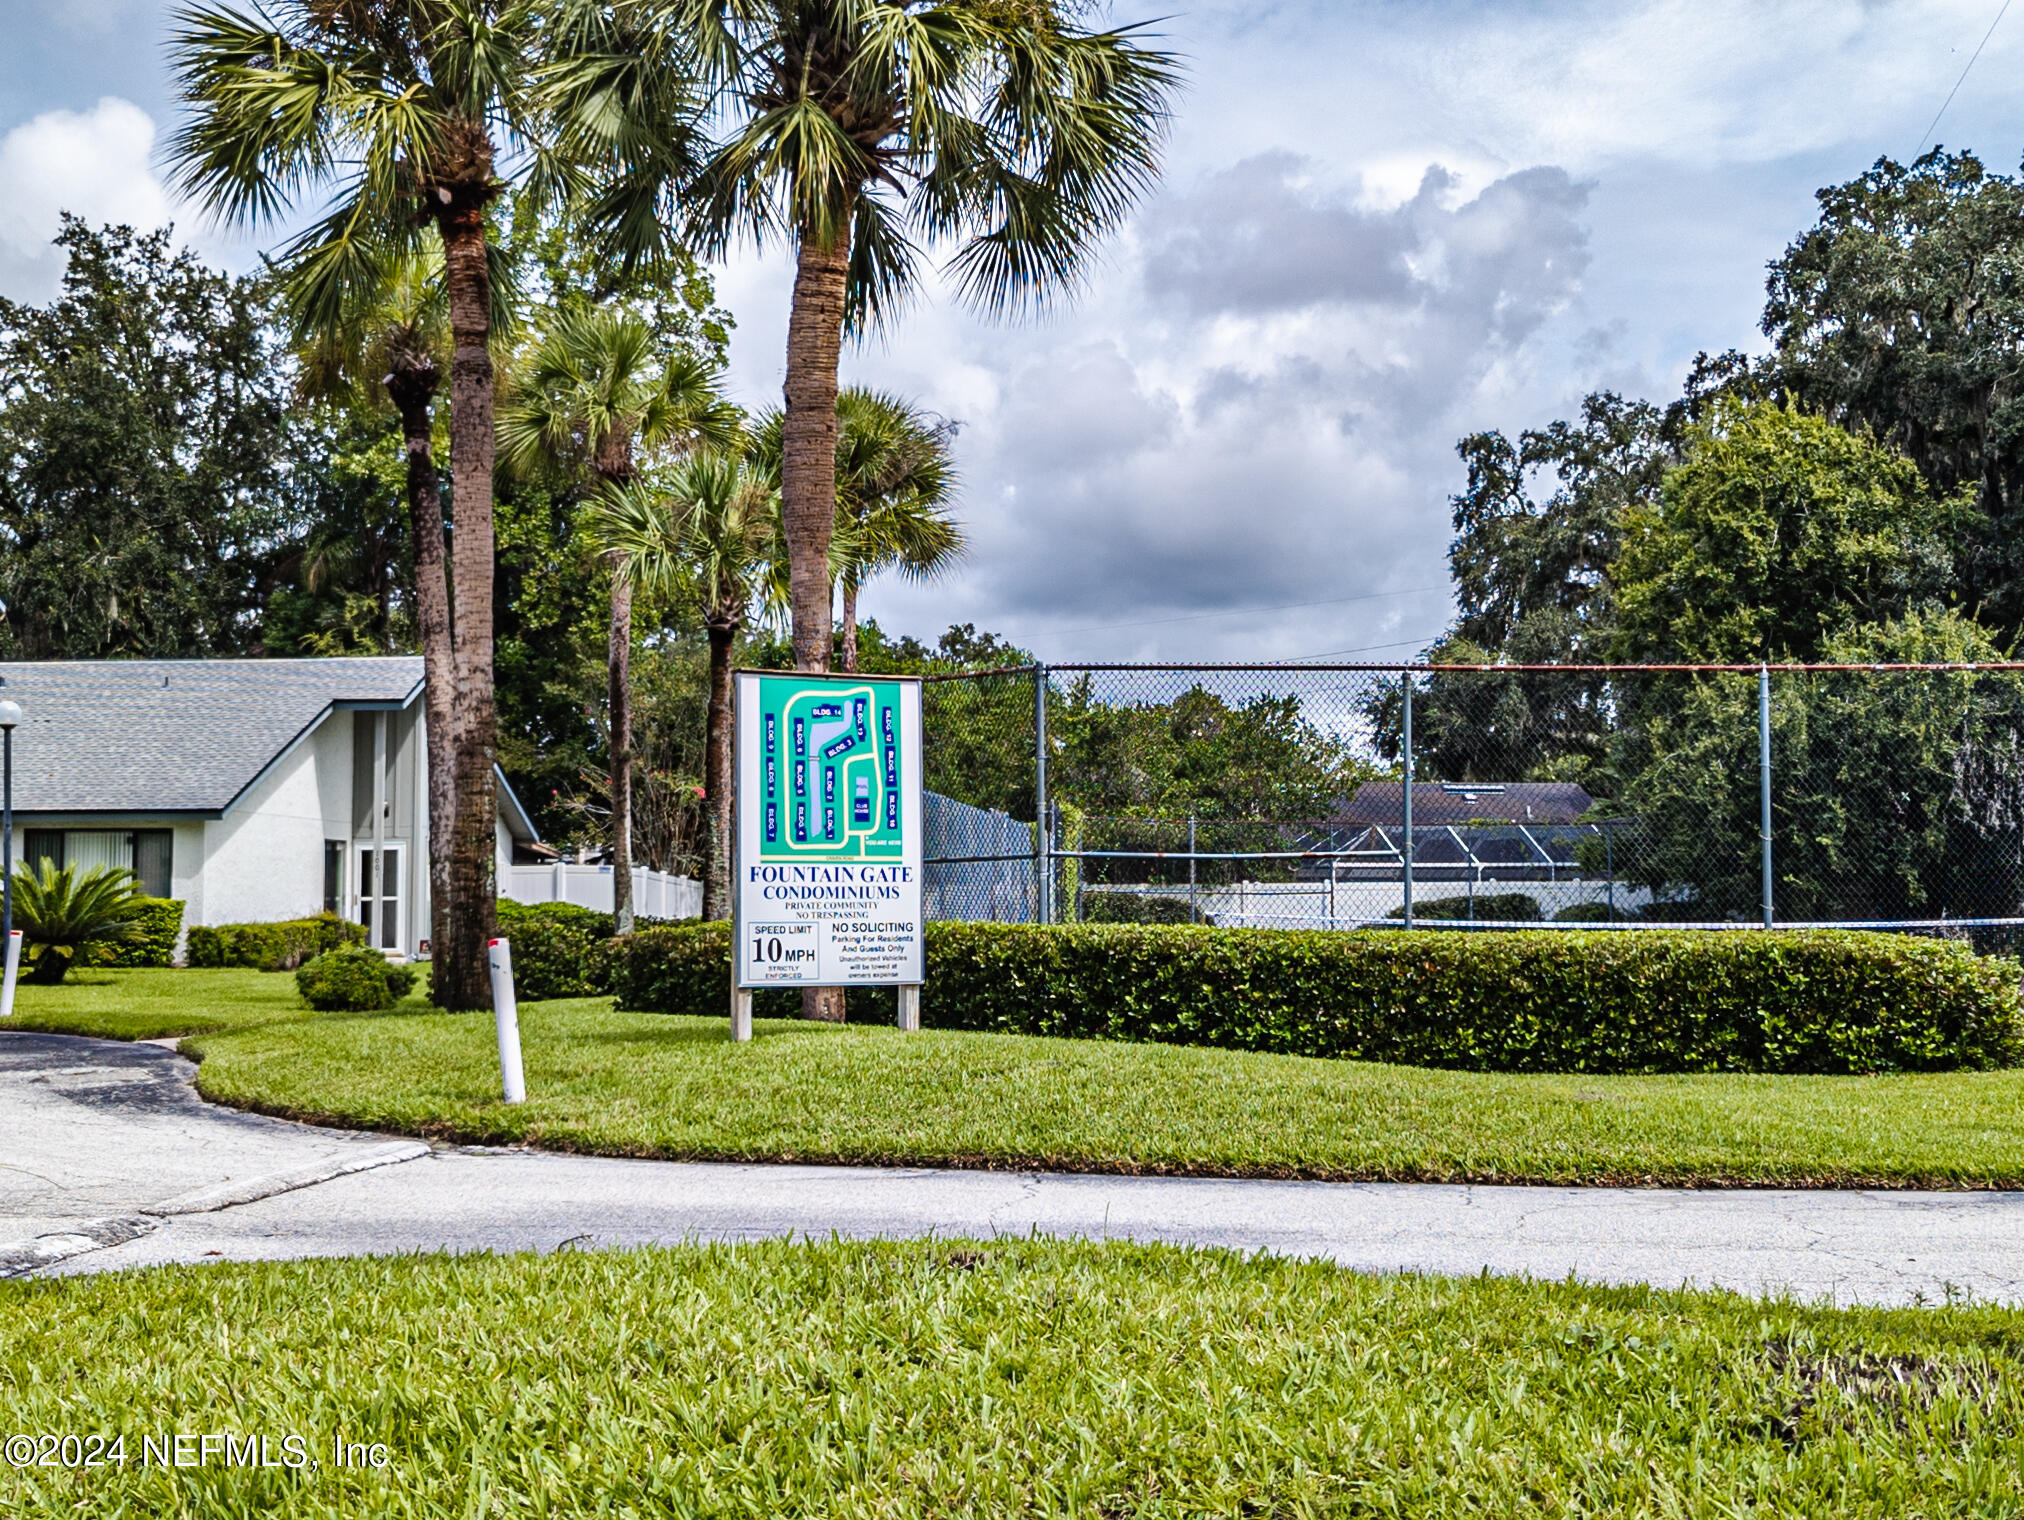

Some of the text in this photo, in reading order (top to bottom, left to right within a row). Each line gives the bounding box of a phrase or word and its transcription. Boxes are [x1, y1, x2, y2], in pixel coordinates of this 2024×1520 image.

[749, 866, 913, 883] FOUNTAIN GATE
[763, 885, 900, 900] CONDOMINIUMS
[785, 902, 879, 910] PRIVATE COMMUNITY
[796, 911, 869, 919] NO TRESPASSING
[755, 925, 812, 934] SPEED LIMIT
[832, 922, 914, 932] NO SOLICITING
[832, 935, 860, 944] Parking
[752, 937, 815, 963] 10 MPH
[888, 944, 905, 953] Only
